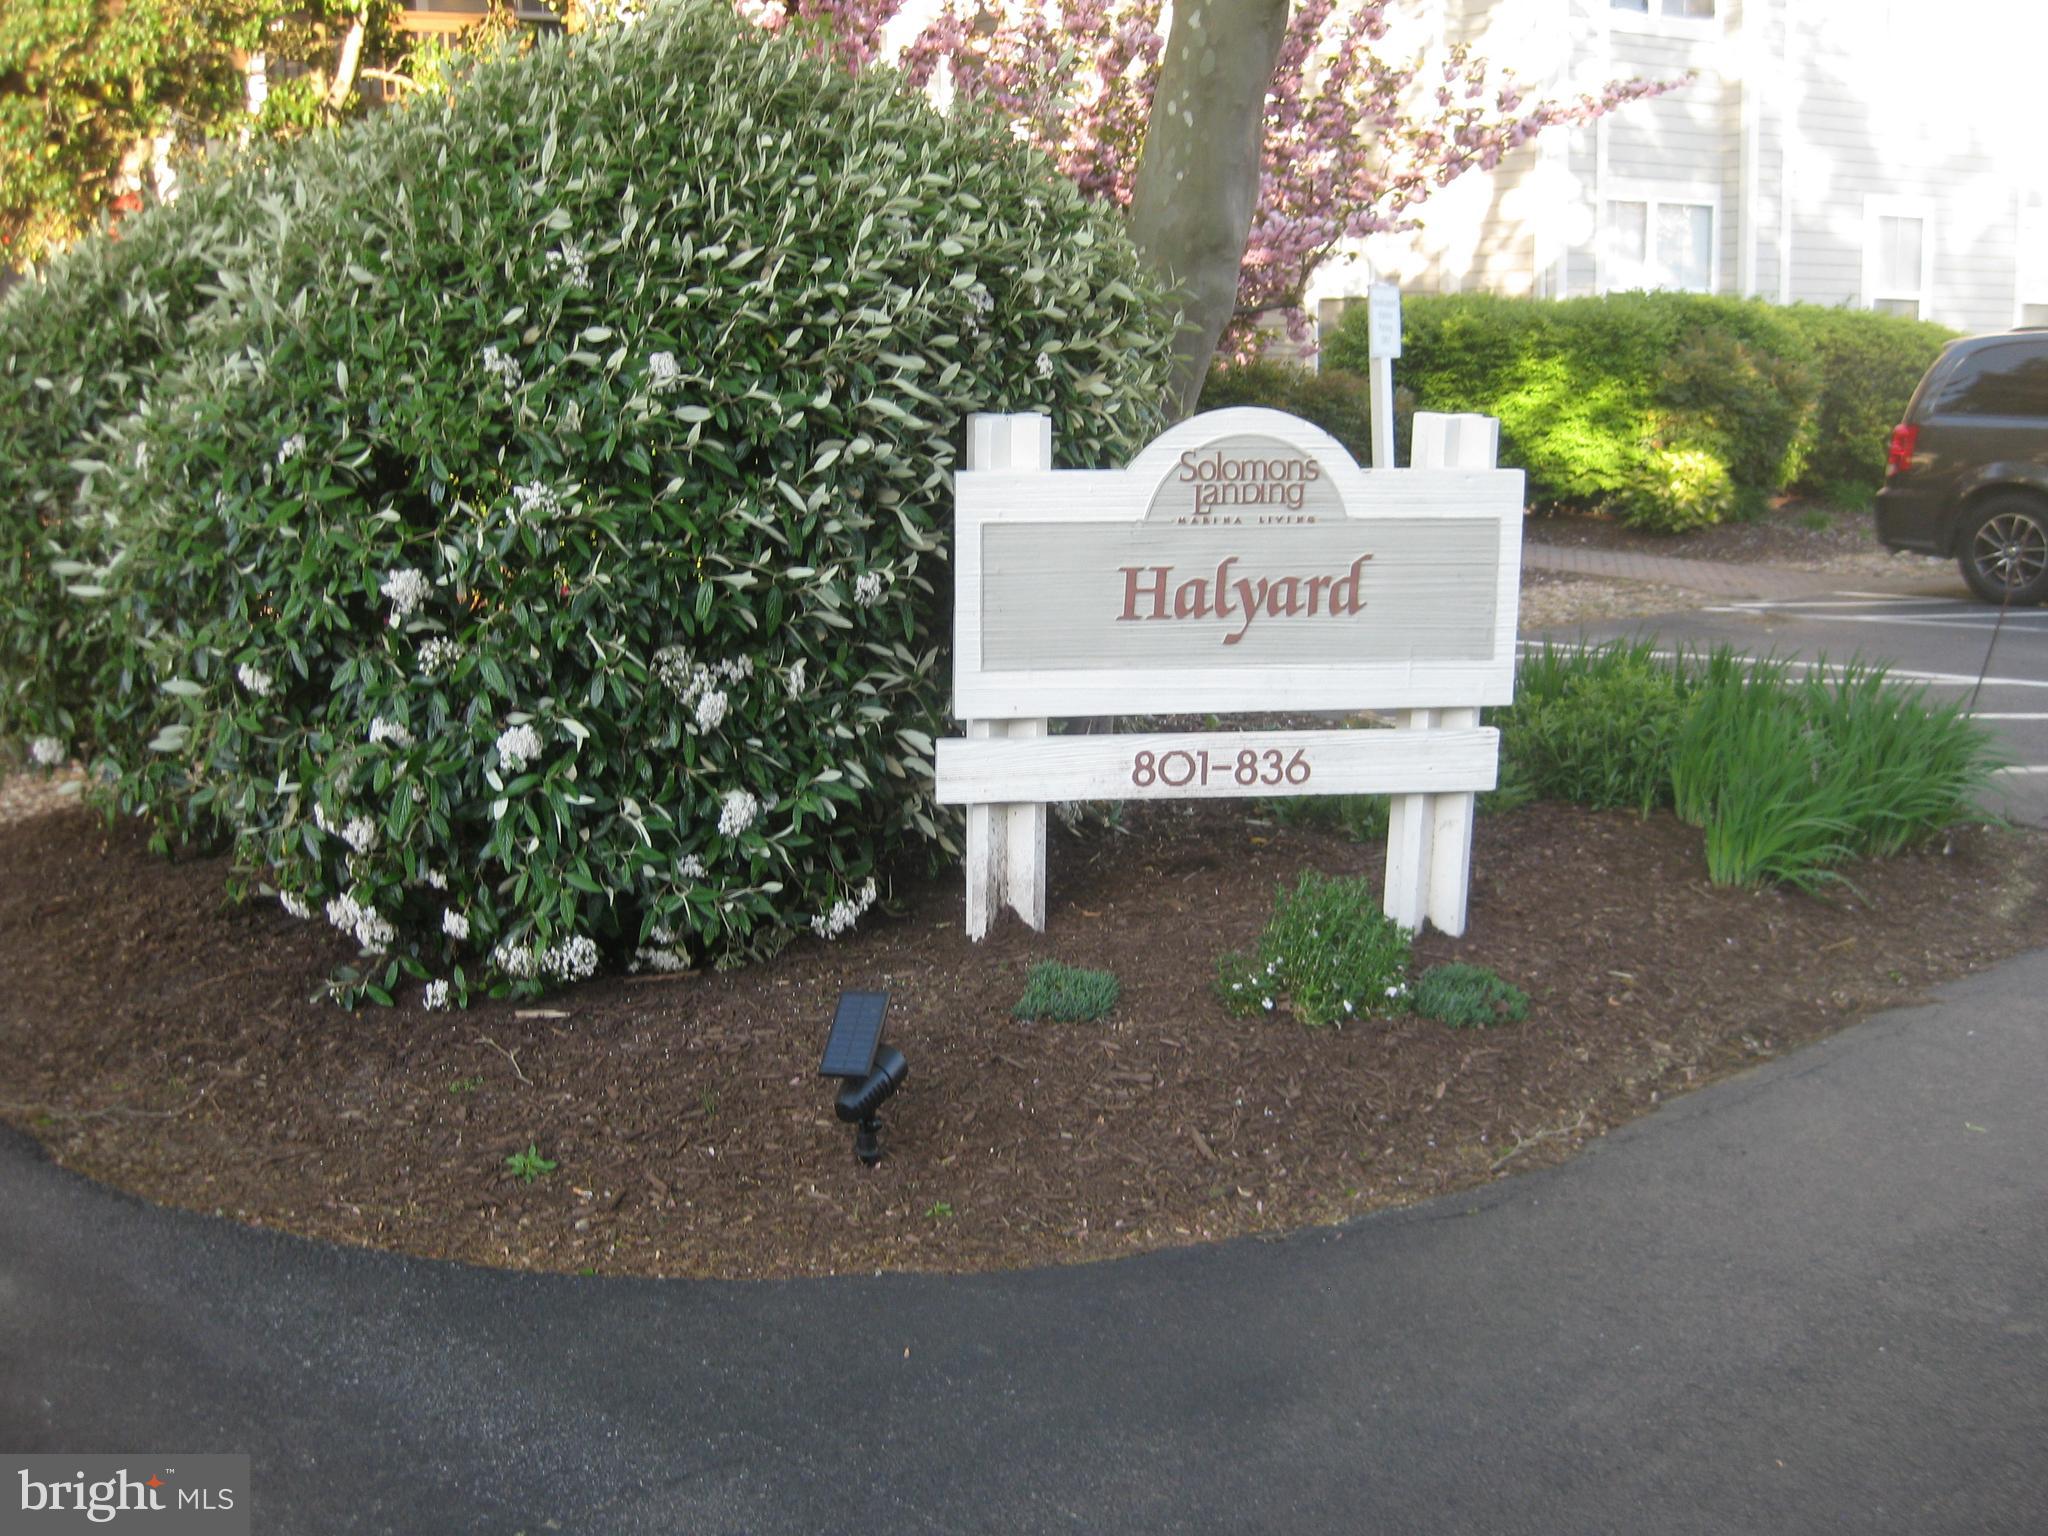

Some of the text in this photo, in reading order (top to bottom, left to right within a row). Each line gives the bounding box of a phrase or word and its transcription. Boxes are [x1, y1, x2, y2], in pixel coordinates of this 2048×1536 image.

[1179, 450, 1320, 482] Solomons
[1177, 516, 1317, 525] MARINA LIVING
[1116, 553, 1374, 645] Halyard
[1132, 748, 1311, 787] 801-836
